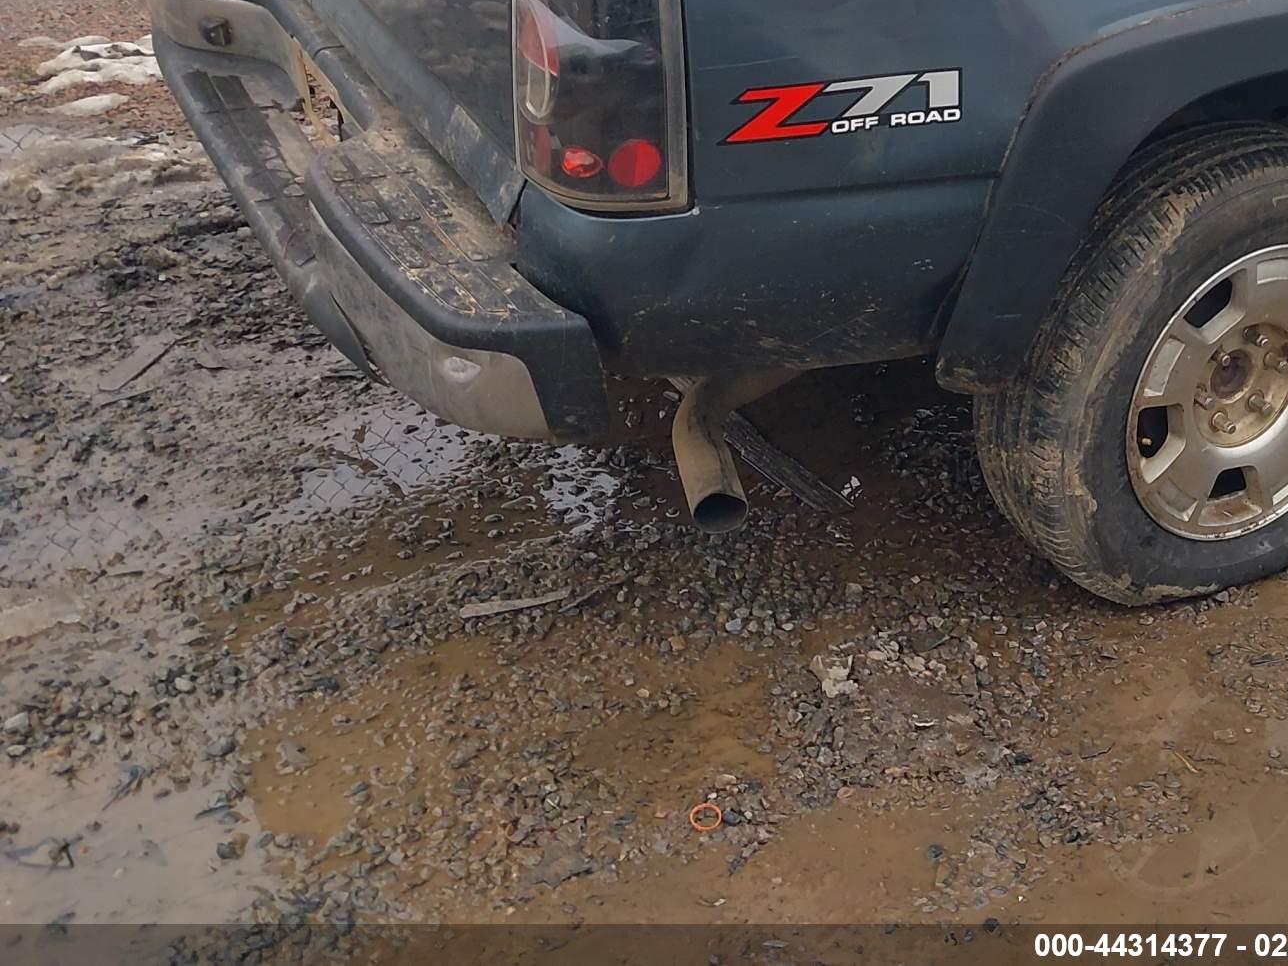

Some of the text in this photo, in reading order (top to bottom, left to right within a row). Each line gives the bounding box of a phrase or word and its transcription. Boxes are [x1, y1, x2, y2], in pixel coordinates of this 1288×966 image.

[724, 69, 961, 144] Z71
[831, 108, 962, 135] OFF ROAD
